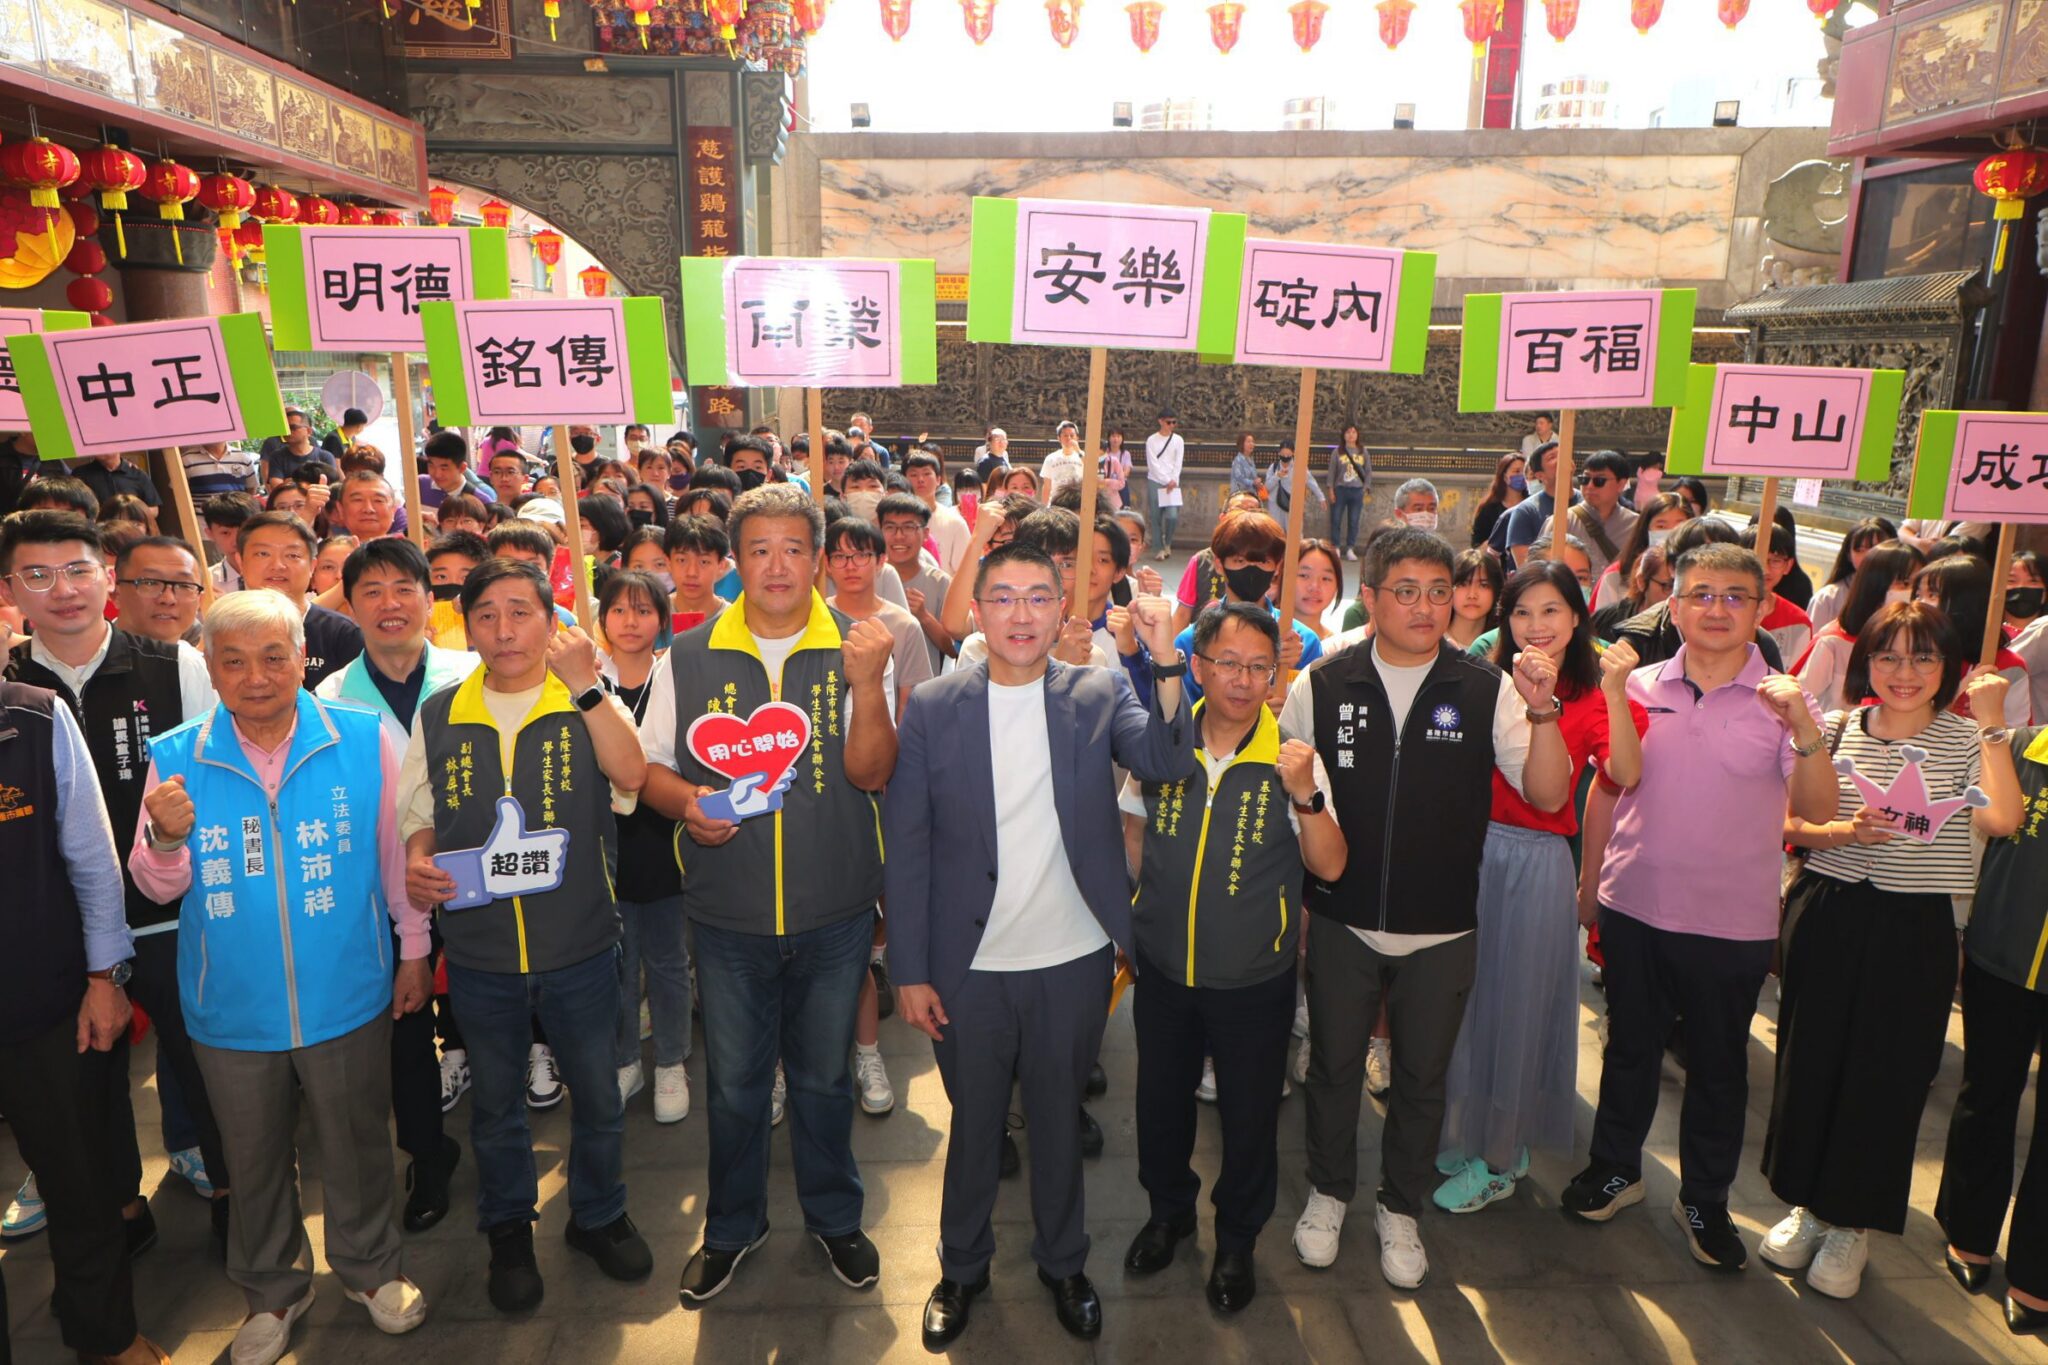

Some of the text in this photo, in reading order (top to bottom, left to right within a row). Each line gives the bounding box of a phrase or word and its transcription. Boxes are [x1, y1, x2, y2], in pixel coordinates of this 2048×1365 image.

[323, 262, 450, 315] 明德
[1033, 242, 1186, 308] 安樂
[1253, 277, 1382, 333] 碇內
[475, 334, 614, 388] 銘傳
[1515, 323, 1643, 374] 百福
[77, 354, 221, 417] 中正
[1730, 395, 1847, 444] 中山
[304, 656, 325, 668] GAP
[707, 729, 800, 762] 用心開始
[243, 818, 263, 874] 秘書長
[331, 785, 352, 854] 立法委員
[199, 824, 236, 920] 沈義傳
[296, 818, 335, 918] 林沛祥
[491, 850, 550, 877] 超讚
